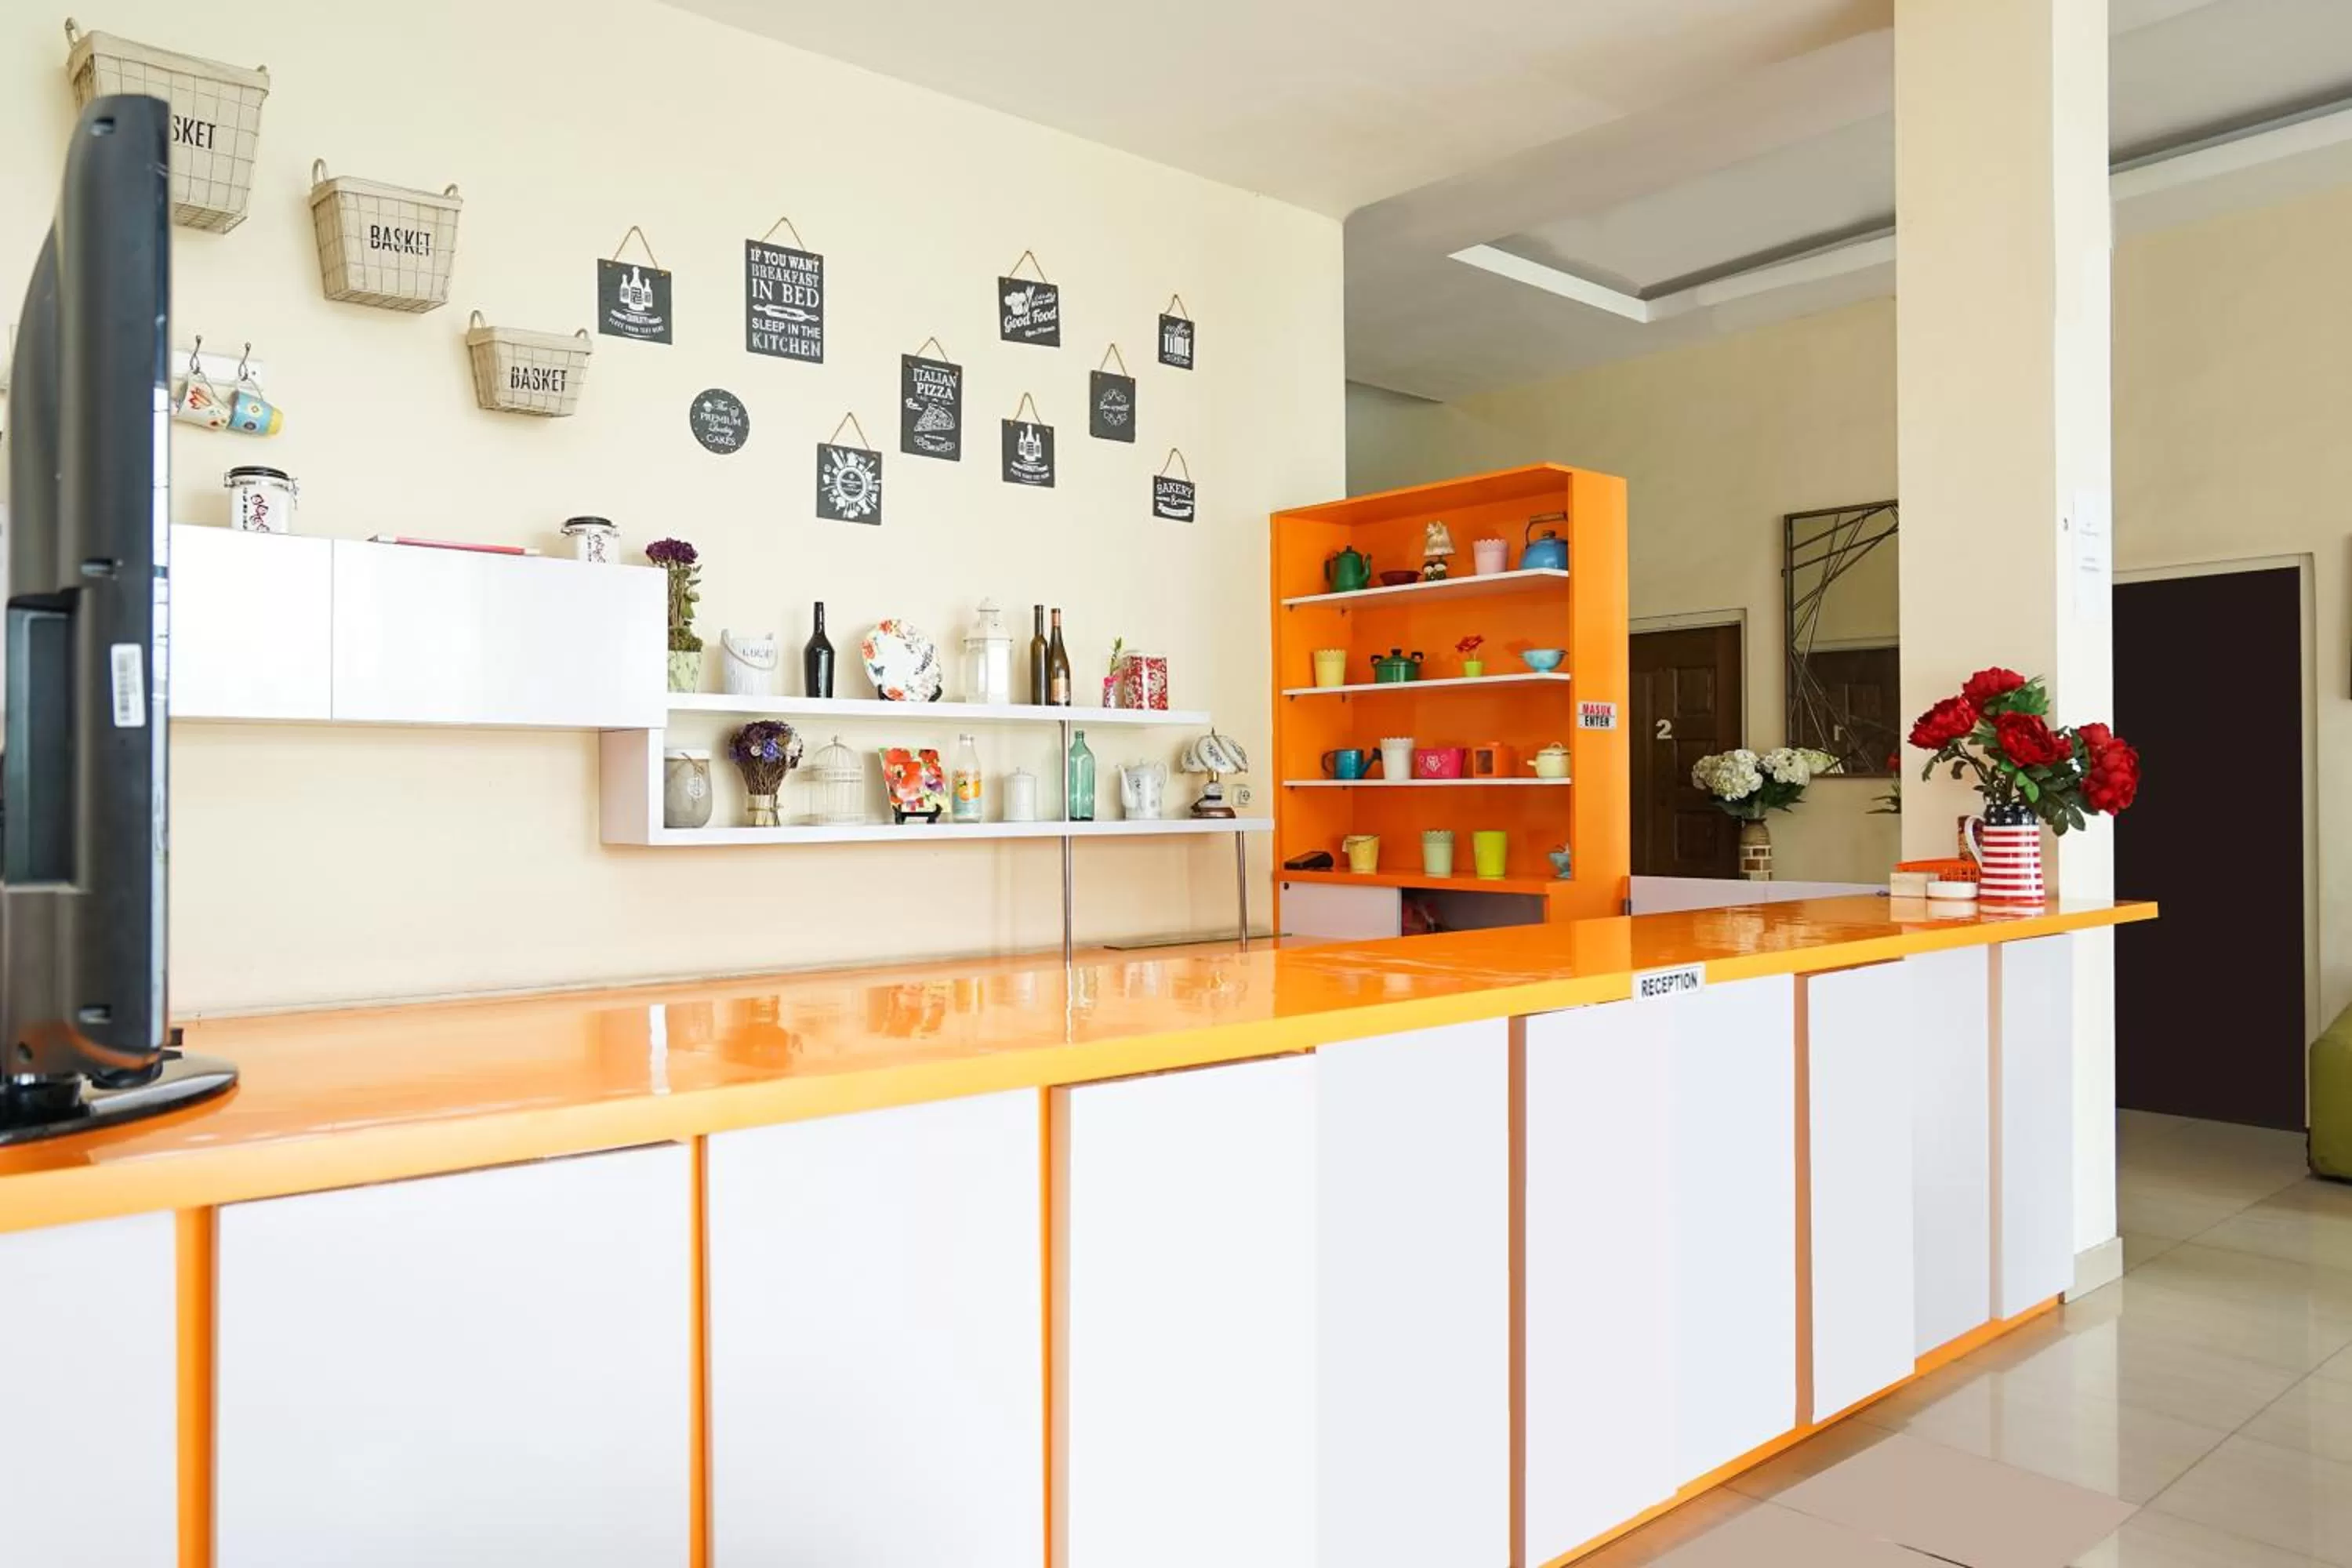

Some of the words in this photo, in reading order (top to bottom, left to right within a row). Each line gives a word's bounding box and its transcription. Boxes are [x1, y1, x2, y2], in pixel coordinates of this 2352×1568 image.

[172, 114, 216, 150] SKET
[370, 225, 430, 257] BASKET
[750, 248, 761, 262] IF
[764, 251, 786, 267] YOU
[789, 256, 819, 273] WANT
[752, 263, 819, 288] BREAKFAST
[752, 278, 773, 301] IN
[782, 283, 819, 308] BED
[752, 318, 785, 332] SLEEP
[788, 324, 799, 336] IN
[801, 325, 822, 339] THE
[1004, 312, 1031, 333] Good
[1032, 306, 1057, 324] Food
[752, 332, 822, 358] KITCHEN
[510, 366, 568, 393] BASKET
[913, 368, 957, 389] ITALIAN
[916, 382, 954, 401] PIZZA
[700, 412, 742, 426] PREMIUM
[706, 434, 736, 446] CAKES
[1156, 482, 1193, 499] BAKERY
[1584, 715, 1610, 728] ENTER
[1656, 719, 1672, 740] 2
[1641, 971, 1698, 998] RECEPTION
